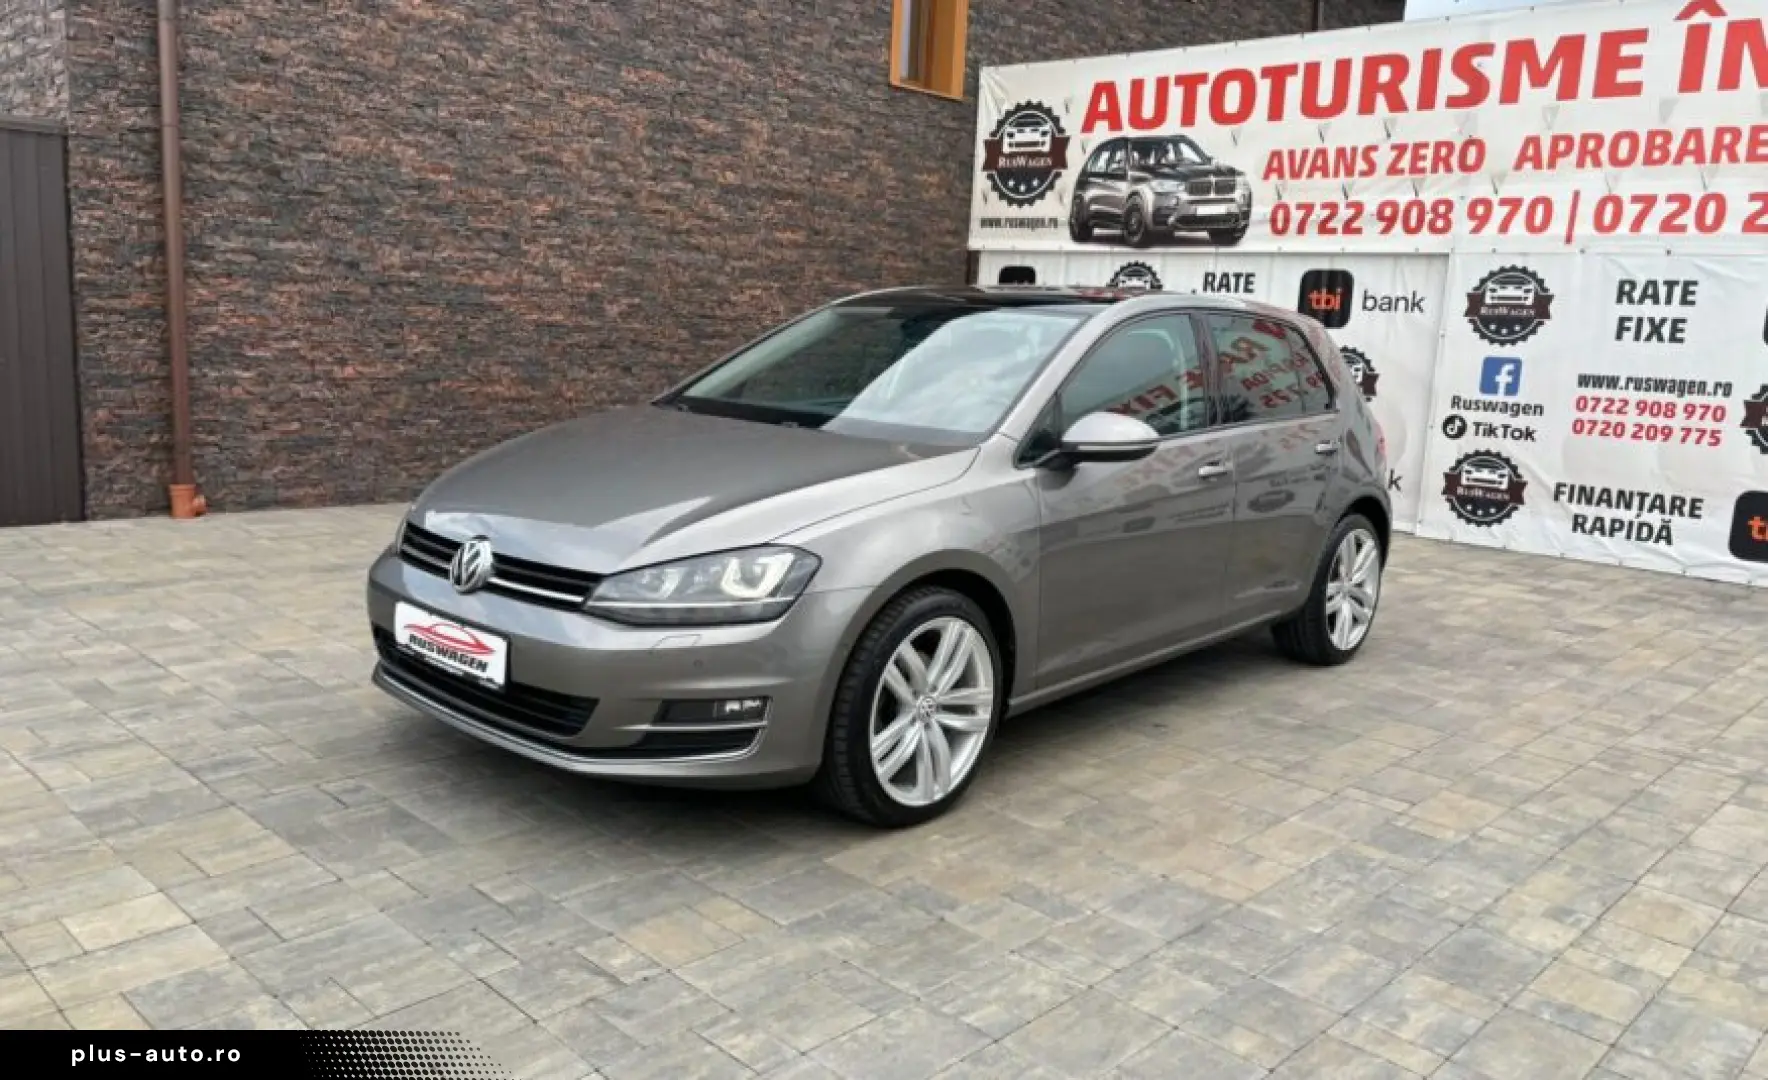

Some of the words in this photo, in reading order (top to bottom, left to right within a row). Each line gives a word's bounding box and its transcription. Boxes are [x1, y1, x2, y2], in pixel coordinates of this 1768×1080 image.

[1080, 28, 1649, 133] AUTOTURISME
[1263, 144, 1378, 180] AVANS
[1386, 138, 1486, 176] ZERO
[1513, 125, 1768, 171] APROBARE
[1269, 202, 1363, 236] 0722
[1374, 198, 1455, 235] 908
[1467, 197, 1554, 234] 970
[1593, 193, 1727, 234] 0720
[1203, 271, 1255, 294] RATE
[1616, 279, 1698, 306] RATE
[1309, 290, 1341, 312] tbi
[1361, 291, 1425, 314] bank
[1615, 316, 1688, 344] FIXE
[1578, 373, 1732, 398] www.ruswagen.ro
[1451, 395, 1544, 417] Ruswagen
[1575, 396, 1628, 415] 0722
[1635, 399, 1676, 419] 908
[1683, 403, 1726, 423] 970
[1473, 422, 1537, 441] TikTok
[1572, 418, 1625, 438] 0720
[1631, 422, 1672, 442] 209
[1680, 427, 1722, 447] 775
[1553, 482, 1704, 520] FINANȚARE
[1572, 513, 1672, 545] RAPIDĂ
[408, 633, 489, 673] RUSWAGEN
